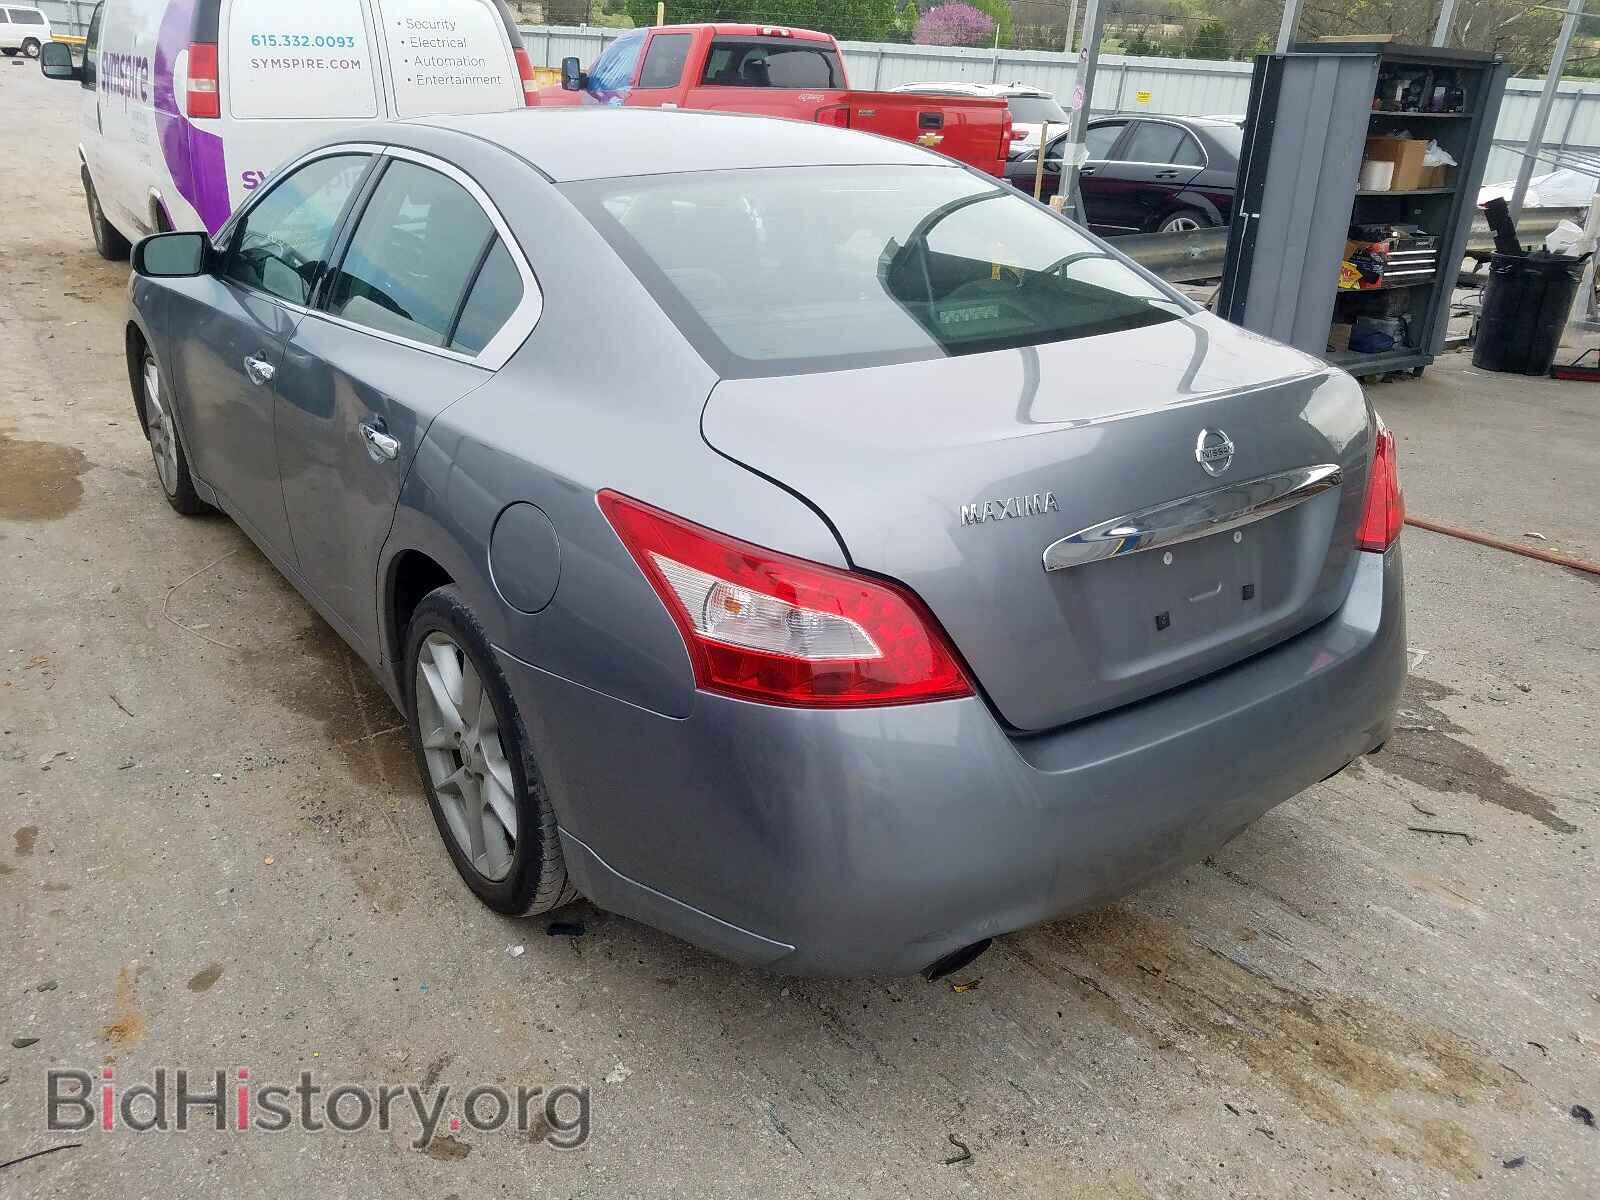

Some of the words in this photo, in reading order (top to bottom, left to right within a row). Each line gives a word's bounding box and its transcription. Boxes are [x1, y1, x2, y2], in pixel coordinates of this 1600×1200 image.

[406, 19, 456, 31] Security
[251, 35, 355, 48] 615.332.0093
[410, 36, 467, 48] Electrical
[251, 58, 361, 70] SYMSPIRE.COM
[414, 56, 486, 67] Automation
[416, 74, 503, 86] Entertainment
[960, 491, 1061, 527] MAXIMA
